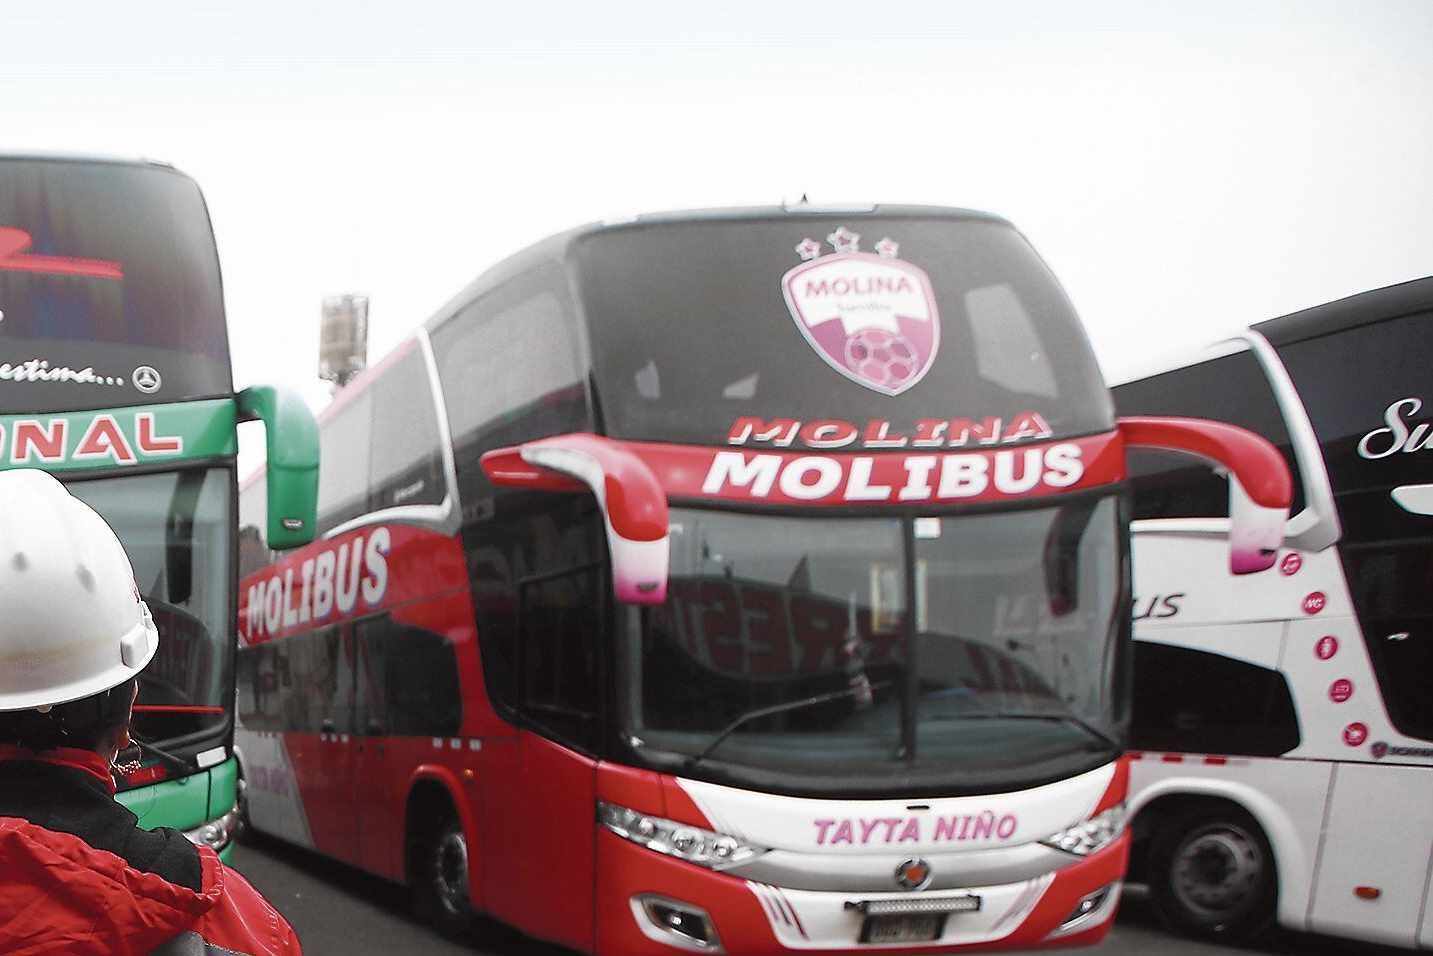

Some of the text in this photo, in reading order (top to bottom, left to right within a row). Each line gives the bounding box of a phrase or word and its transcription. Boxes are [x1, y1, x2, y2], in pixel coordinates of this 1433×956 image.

[805, 277, 914, 298] MOLINA
[727, 411, 1054, 448] MOLINA
[701, 443, 1085, 500] MOLIBUS
[247, 526, 391, 640] MOLIBUS
[813, 809, 1017, 845] TAYTA NIÑO
